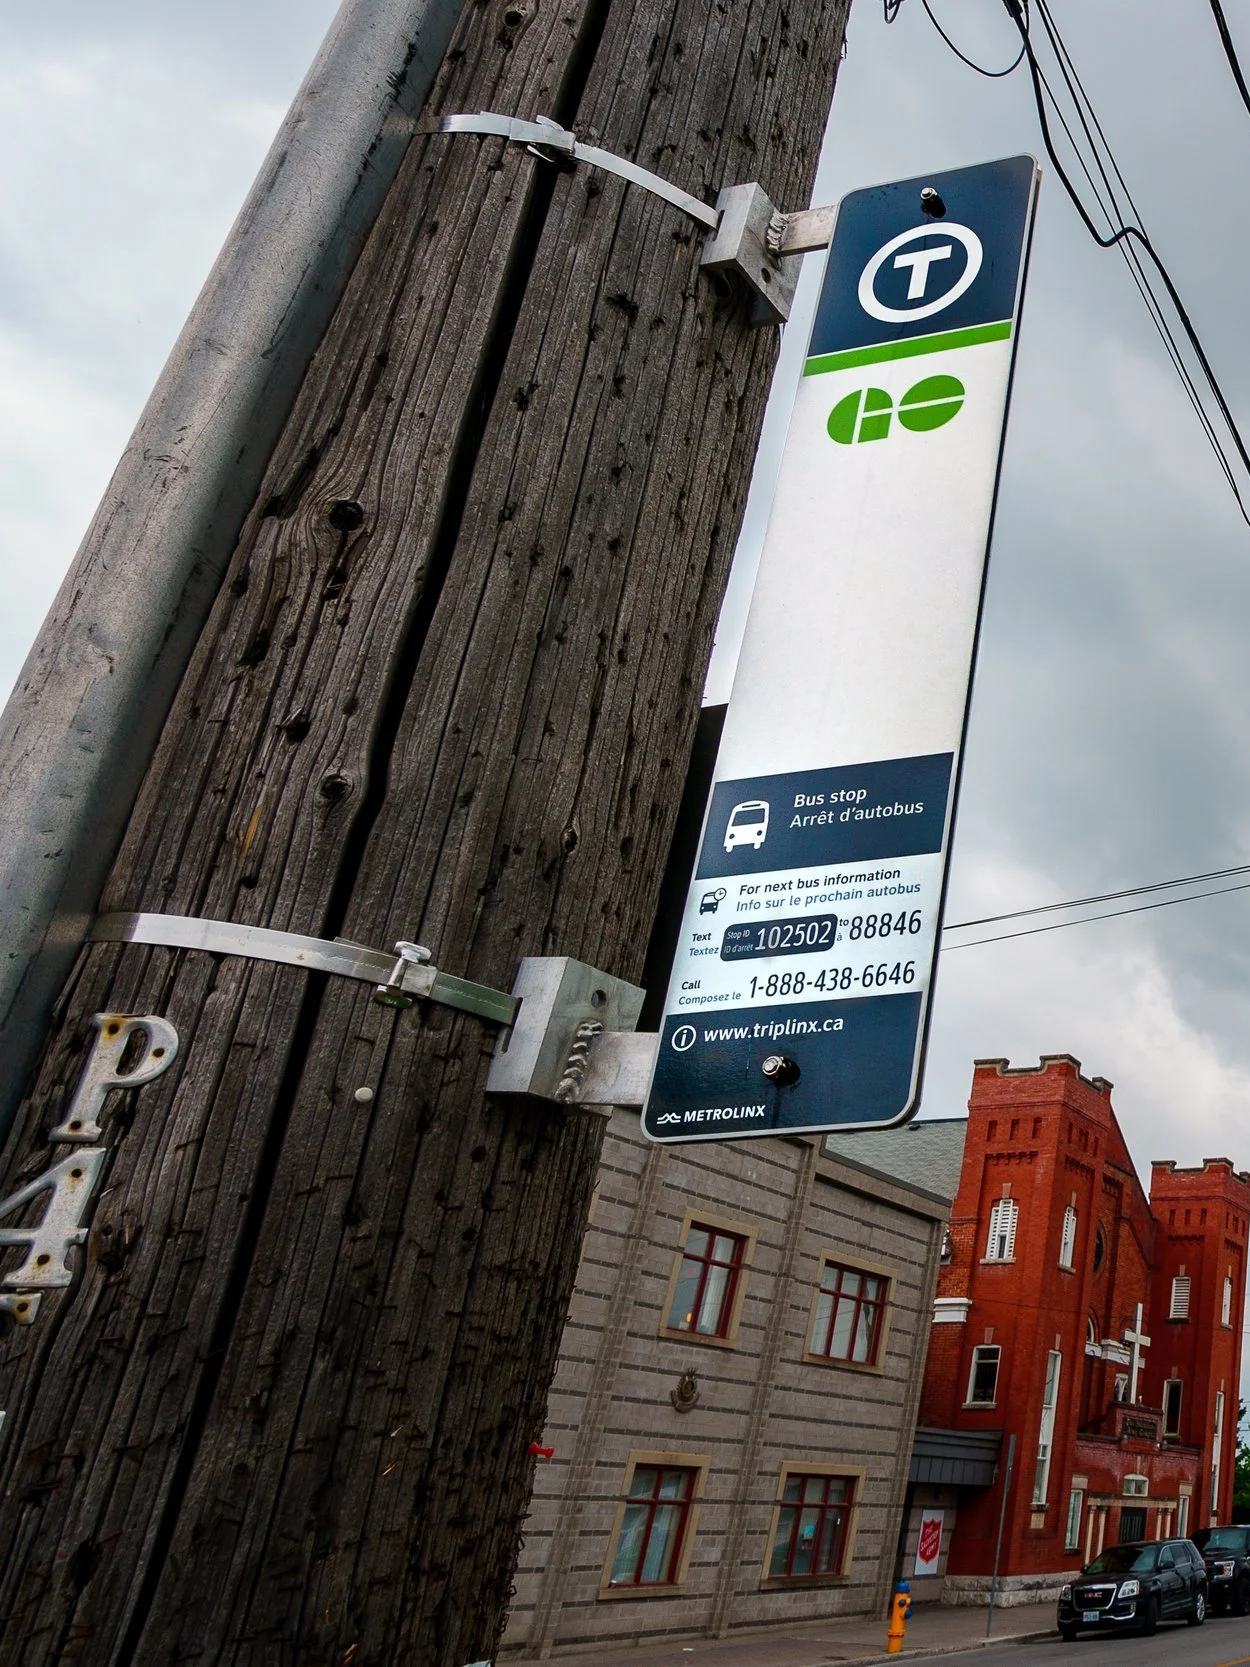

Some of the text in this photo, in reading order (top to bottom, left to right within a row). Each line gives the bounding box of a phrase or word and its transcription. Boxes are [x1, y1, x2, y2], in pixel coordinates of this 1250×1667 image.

[893, 244, 952, 300] T
[826, 374, 966, 445] GO
[794, 787, 867, 808] Bus stop
[789, 800, 924, 829] Arrêt d'autobus
[739, 867, 901, 896] For next bus information
[736, 882, 921, 912] Info sur le prochain autobus
[839, 918, 850, 927] to
[849, 909, 922, 942] 88846
[692, 932, 712, 942] Text
[726, 929, 751, 940] Stop ID
[754, 920, 832, 951] 102502
[836, 932, 843, 942] à
[689, 946, 719, 957] Textez
[723, 946, 731, 954] ID
[681, 979, 701, 990] Call
[749, 960, 916, 999] 1-888-438-6646
[678, 991, 742, 1008] Composez le
[704, 1016, 844, 1043] www.triplinx.ca
[683, 1105, 766, 1123] METROLINX
